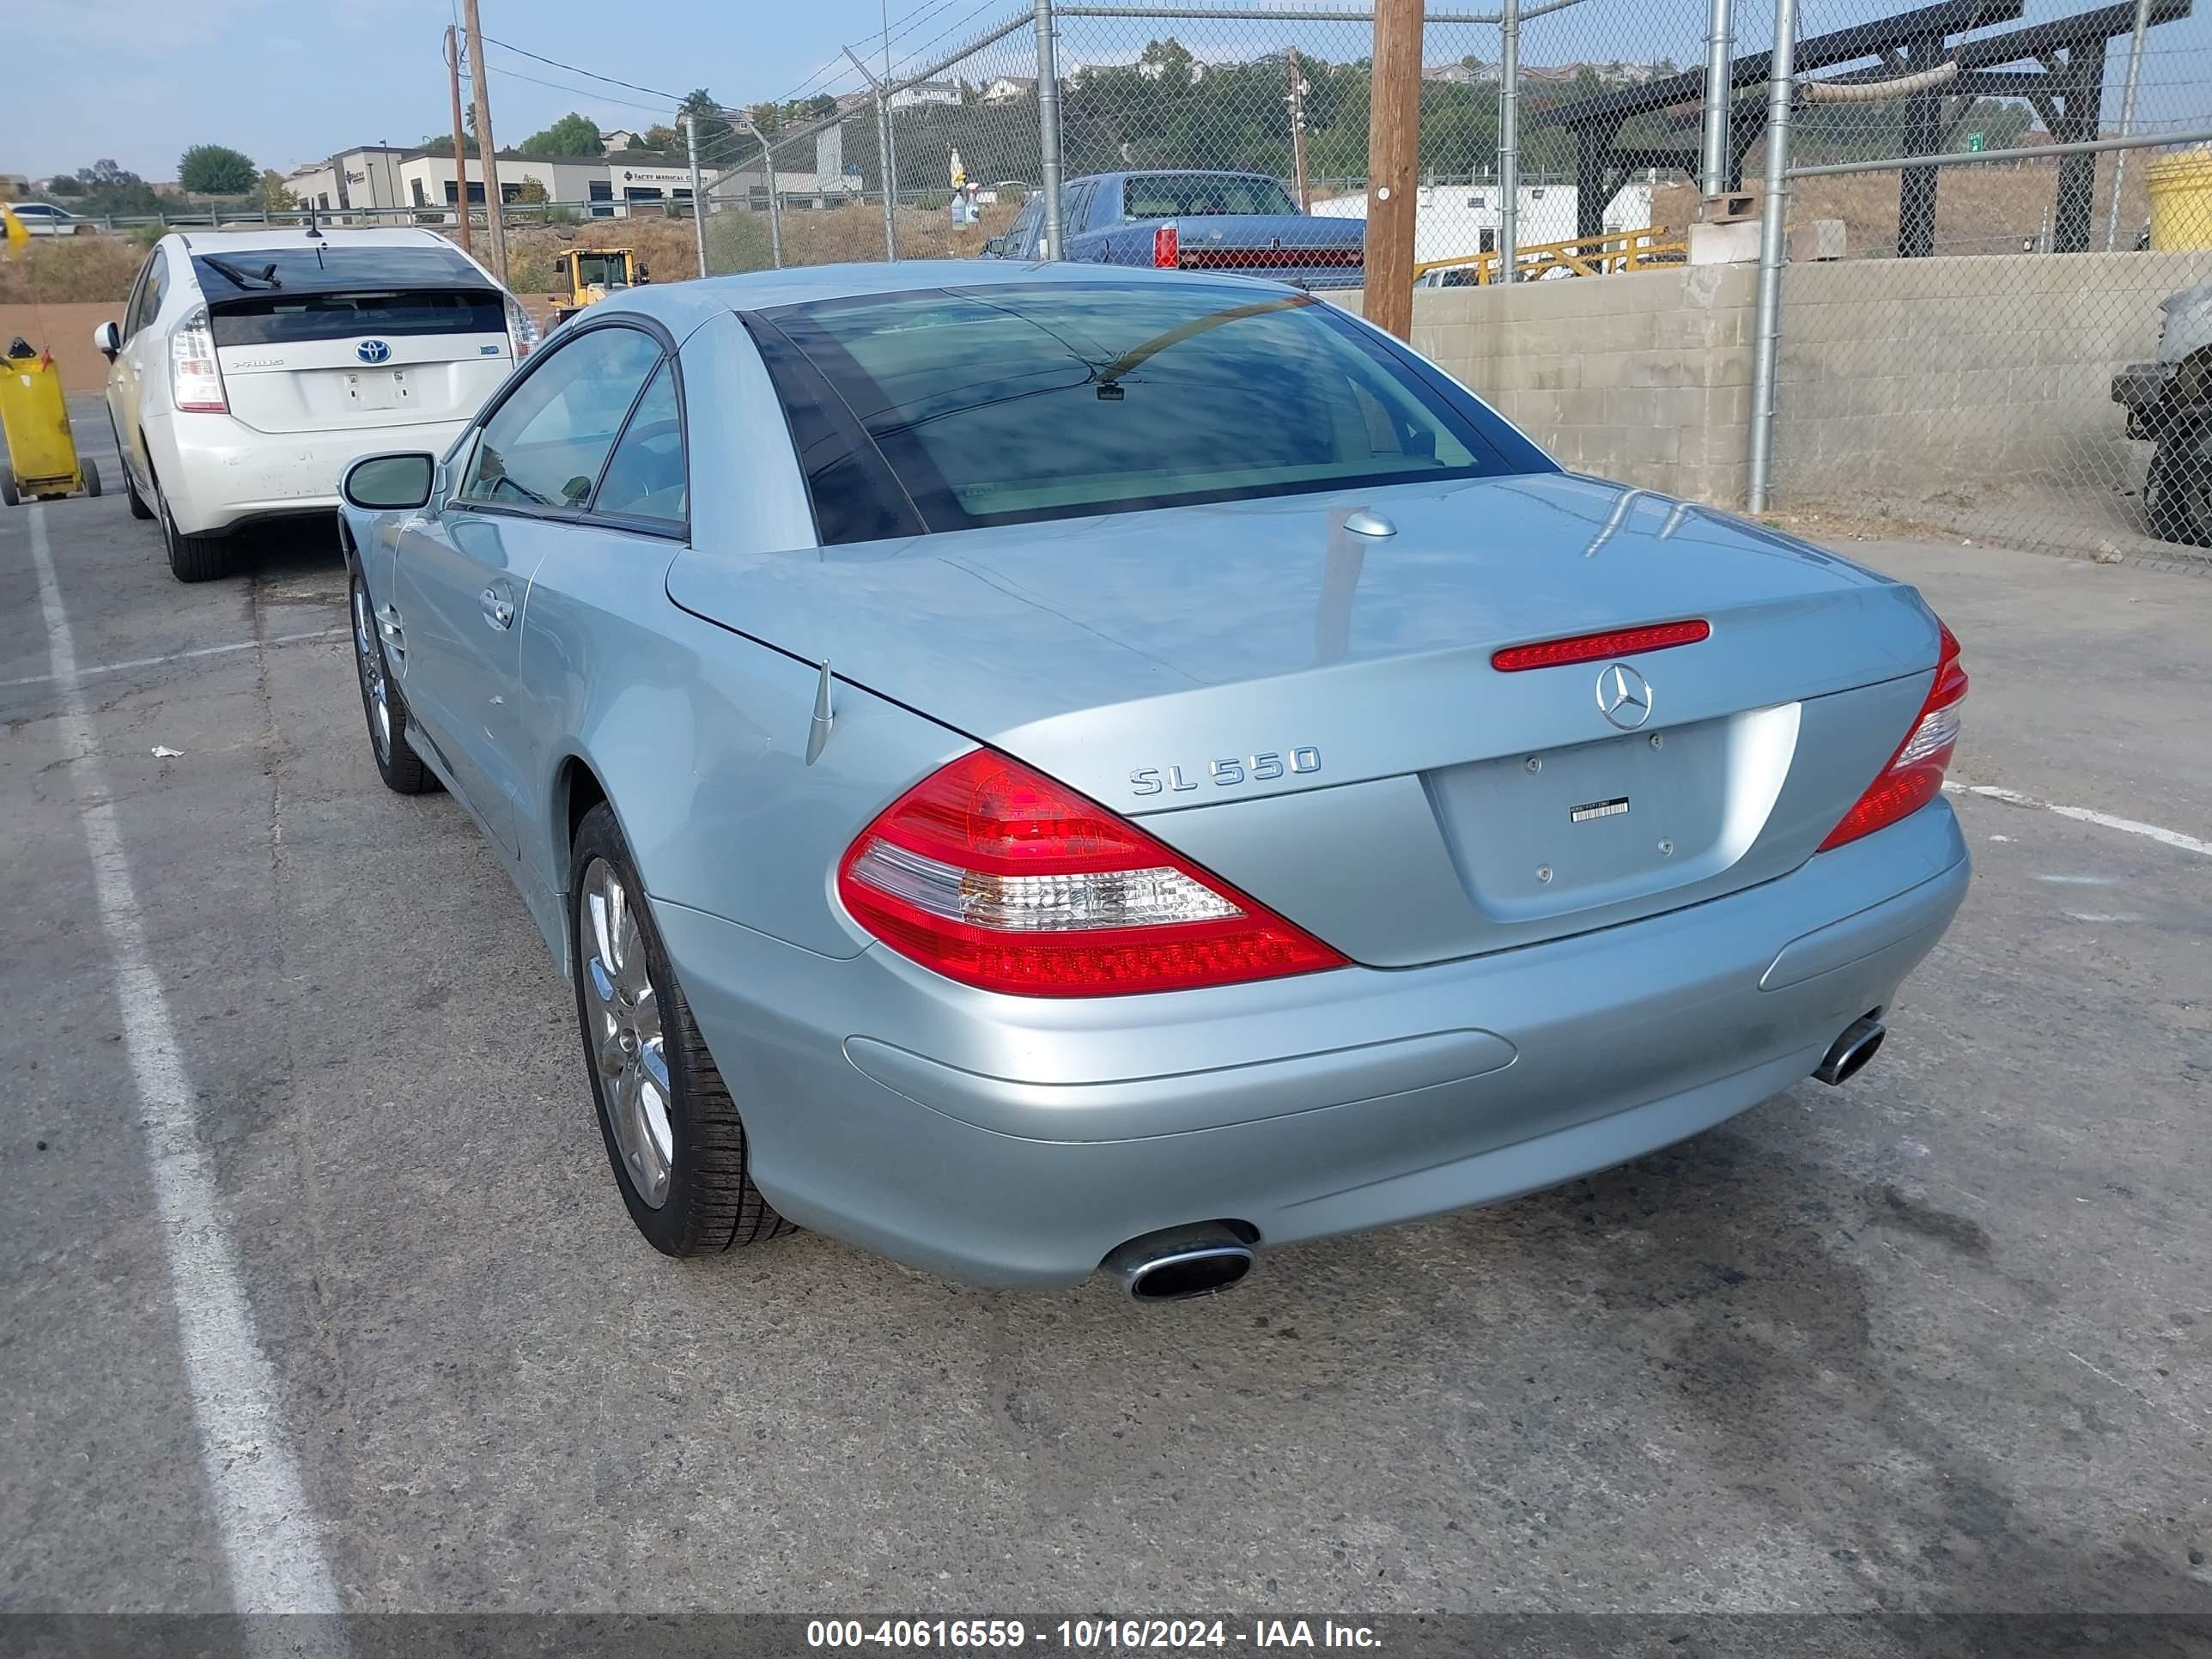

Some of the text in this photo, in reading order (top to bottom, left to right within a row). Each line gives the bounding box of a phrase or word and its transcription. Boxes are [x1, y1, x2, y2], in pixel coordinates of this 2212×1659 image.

[233, 359, 284, 368] PRIUS
[1129, 745, 1322, 796] SL 550
